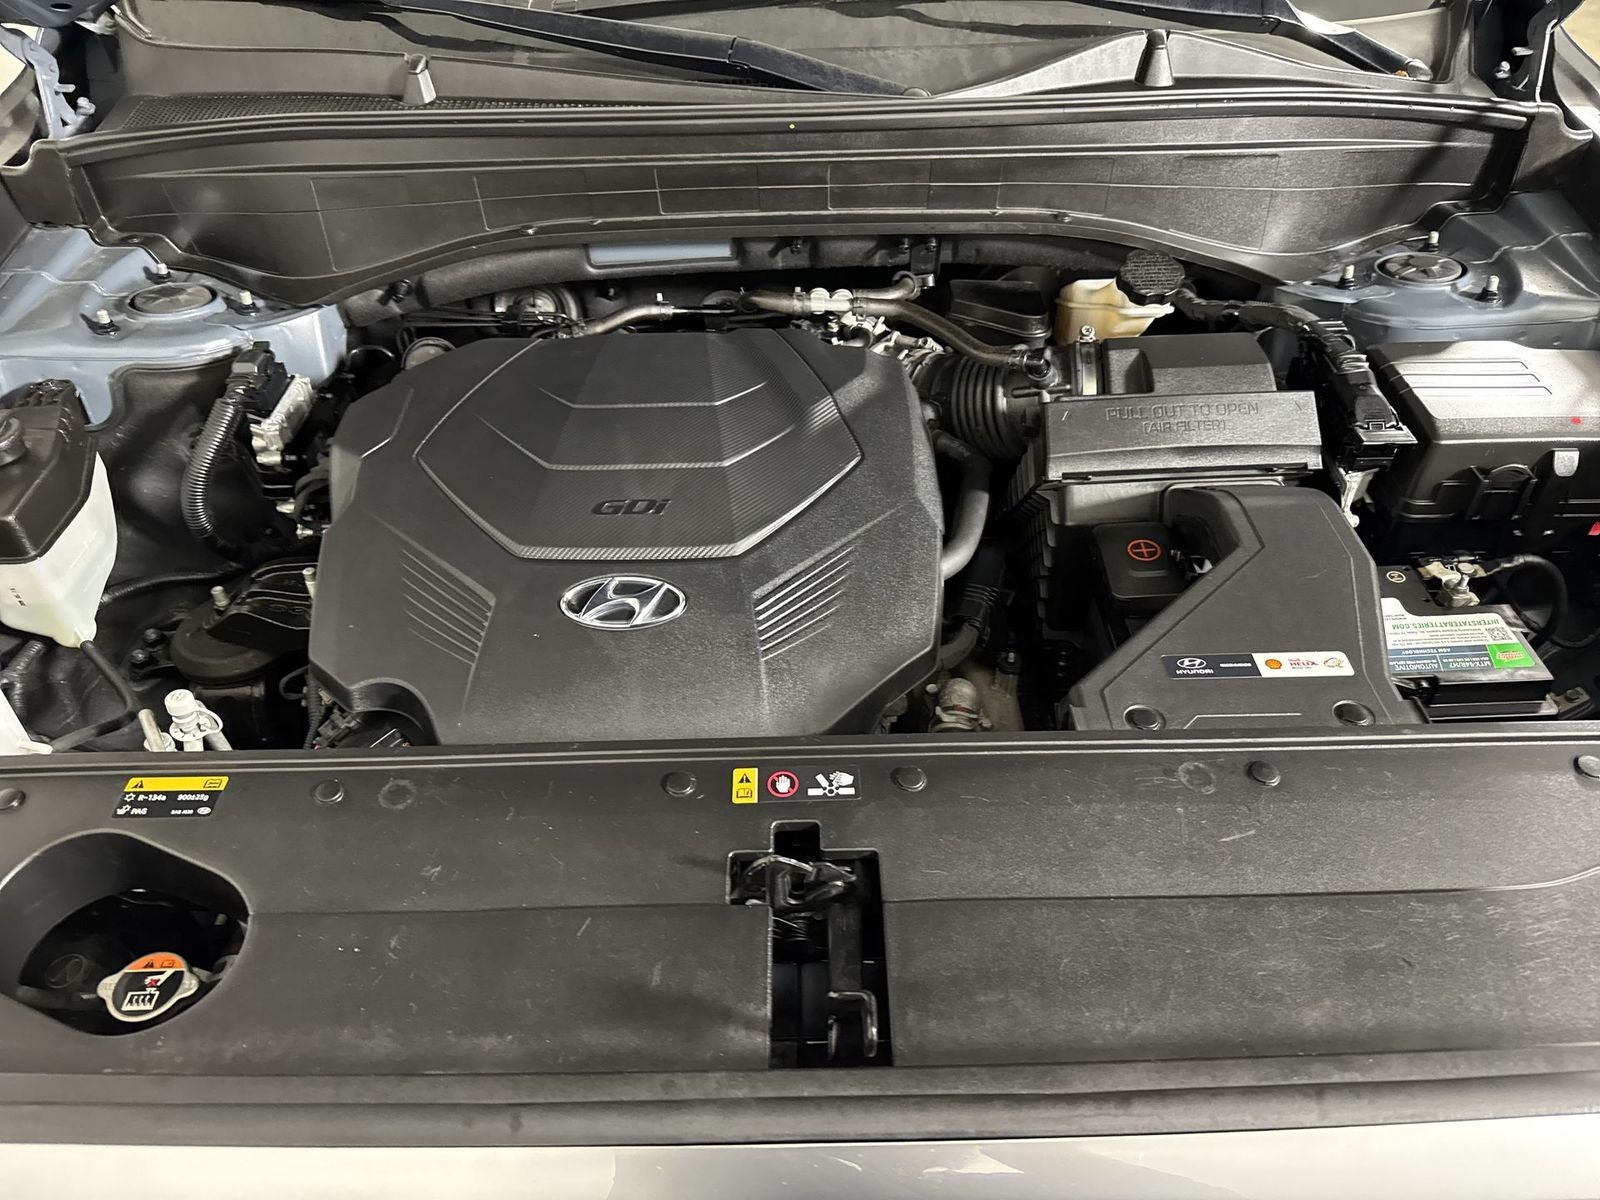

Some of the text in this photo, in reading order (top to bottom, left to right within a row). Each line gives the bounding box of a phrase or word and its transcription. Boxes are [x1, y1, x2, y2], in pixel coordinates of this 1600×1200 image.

[1105, 402, 1259, 421] PULL OUT TO OPEN
[591, 498, 671, 515] GDi
[1392, 618, 1500, 630] INTERSTATEBATTERIES.COM
[1394, 662, 1438, 671] AUTOMOTIVE
